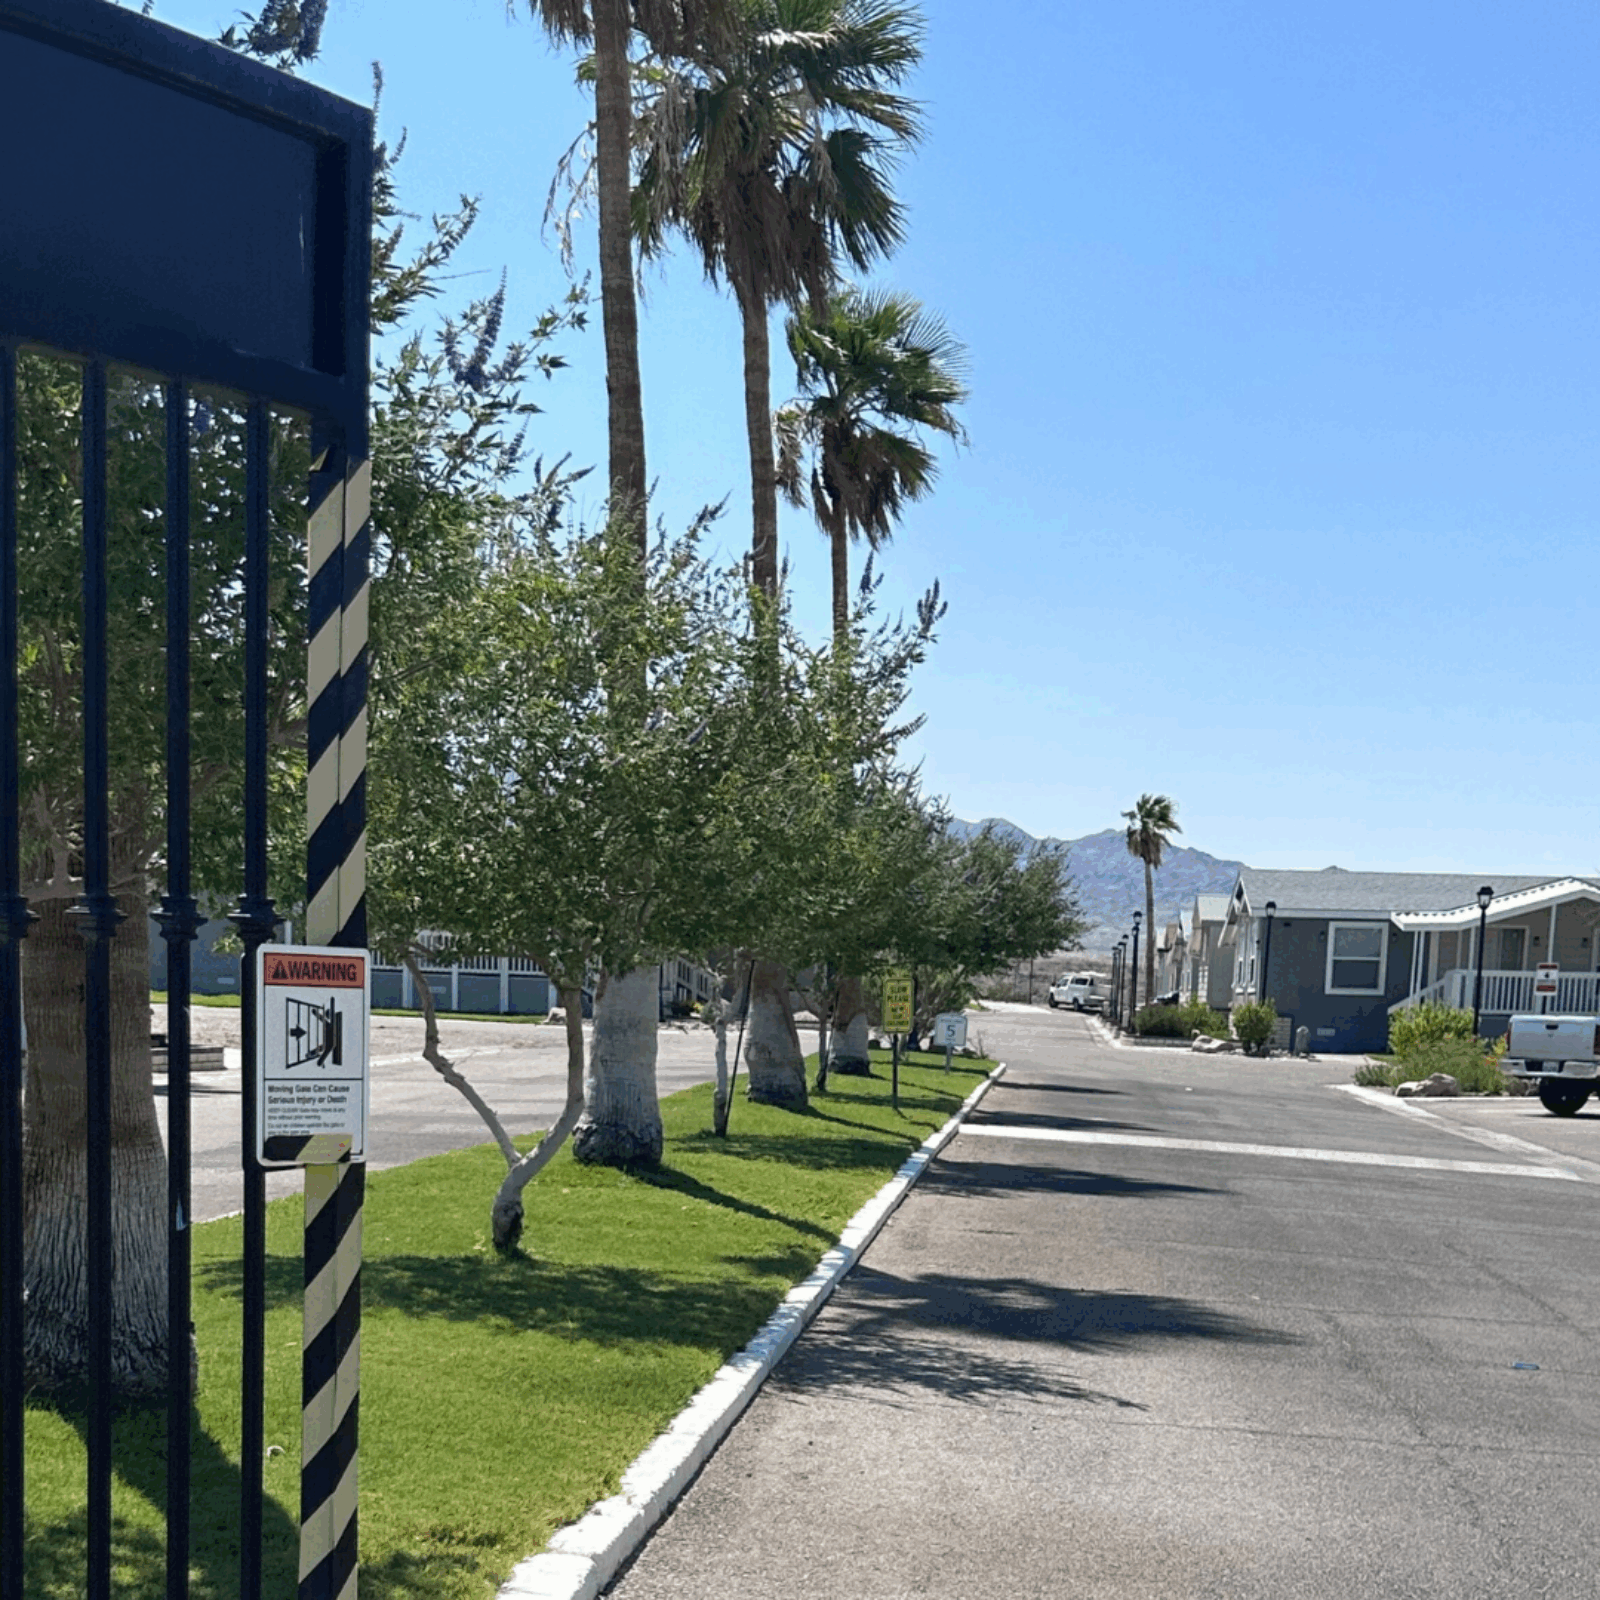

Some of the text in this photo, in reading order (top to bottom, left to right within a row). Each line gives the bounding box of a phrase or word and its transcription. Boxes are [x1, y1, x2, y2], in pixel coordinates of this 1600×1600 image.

[288, 960, 357, 982] WARNING
[947, 1025, 956, 1037] 5
[267, 1085, 294, 1095] Moving
[312, 1084, 327, 1093] Can
[328, 1084, 350, 1093] Cause
[267, 1095, 295, 1104] Serious
[296, 1095, 317, 1106] Injury
[327, 1095, 347, 1104] Death
